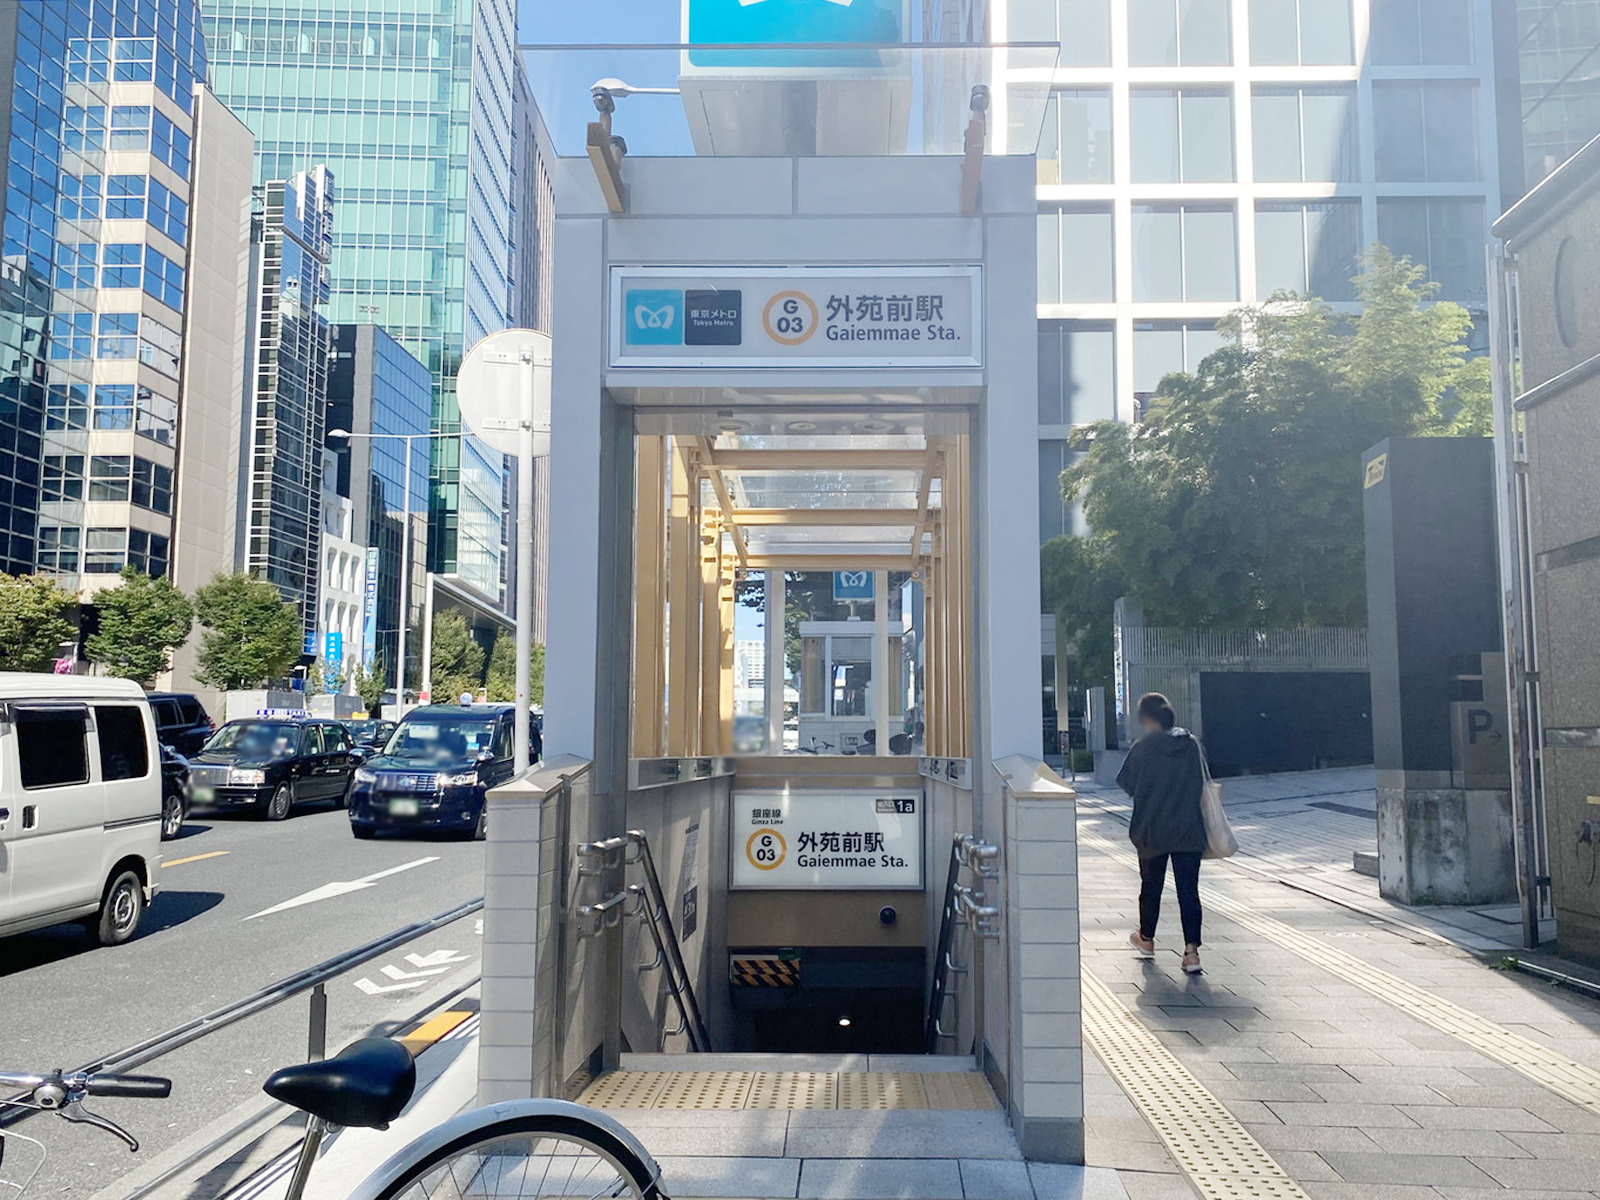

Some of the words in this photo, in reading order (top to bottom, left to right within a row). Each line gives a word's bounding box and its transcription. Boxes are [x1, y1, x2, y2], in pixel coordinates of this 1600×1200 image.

[783, 299, 799, 314] G
[825, 294, 944, 322] 外苑前駅
[690, 309, 737, 319] 東京メトロ
[693, 319, 713, 327] Tokyo
[713, 319, 735, 327] Metro
[777, 316, 804, 334] 03
[826, 324, 921, 341] Gaiemmae
[927, 324, 961, 341] Sta.
[1468, 709, 1494, 745] P
[752, 808, 781, 818] 銀座線
[897, 800, 913, 813] 1a
[761, 835, 772, 847] G
[797, 831, 884, 853] 外苑前駅
[756, 848, 775, 861] 03
[797, 854, 875, 868] Gaiemmae
[881, 854, 908, 868] Sta.
